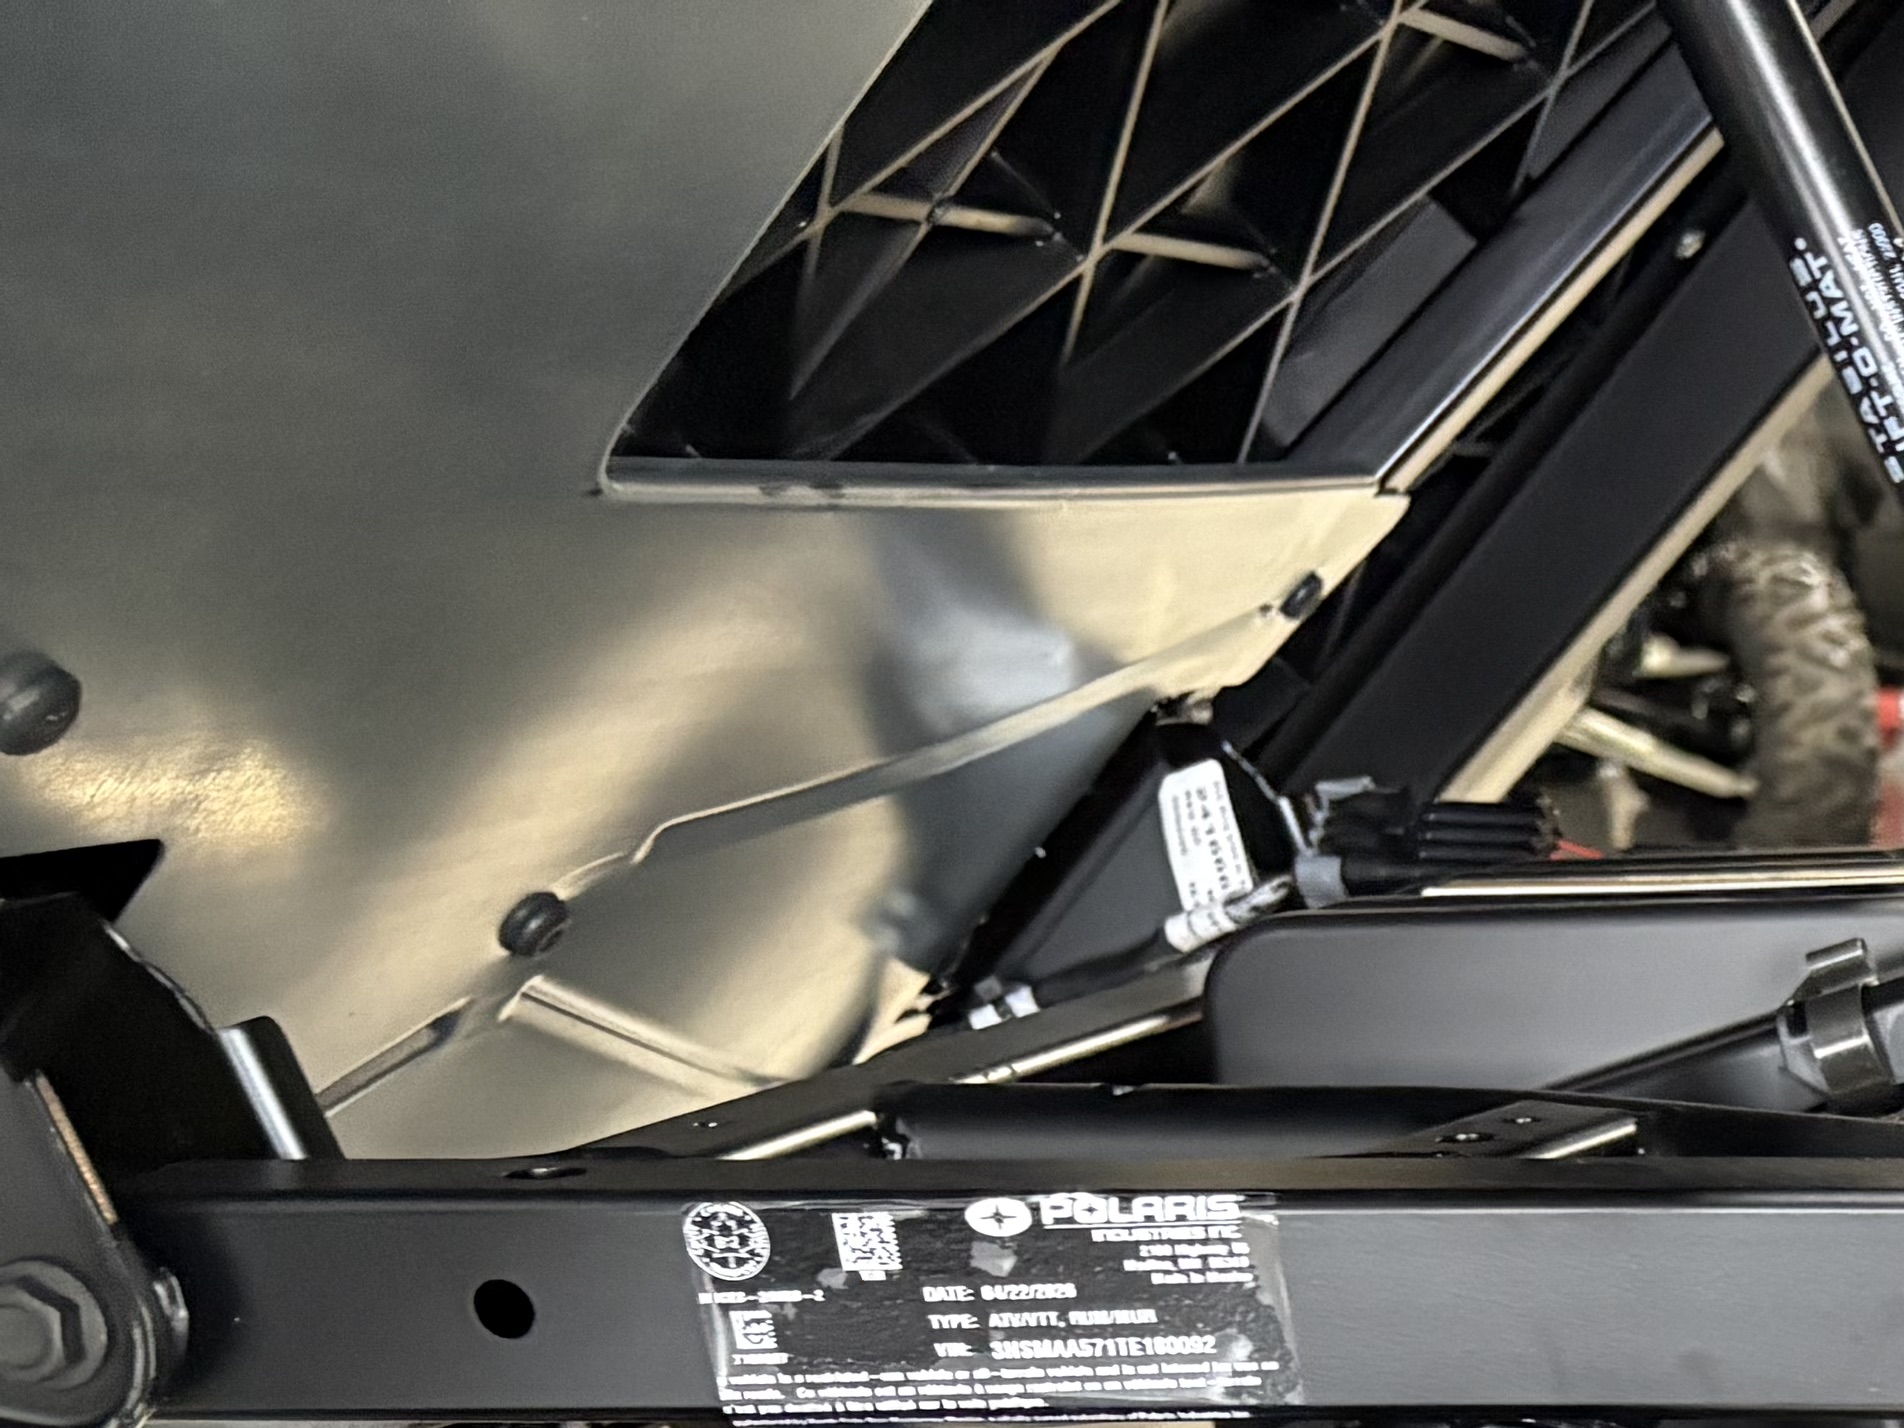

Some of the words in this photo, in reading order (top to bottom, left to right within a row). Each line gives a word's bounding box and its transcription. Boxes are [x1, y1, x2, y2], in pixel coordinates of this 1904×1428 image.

[1039, 1192, 1243, 1225] POLARIS
[922, 1285, 976, 1302] DATE:
[927, 1313, 982, 1329] TYPE:
